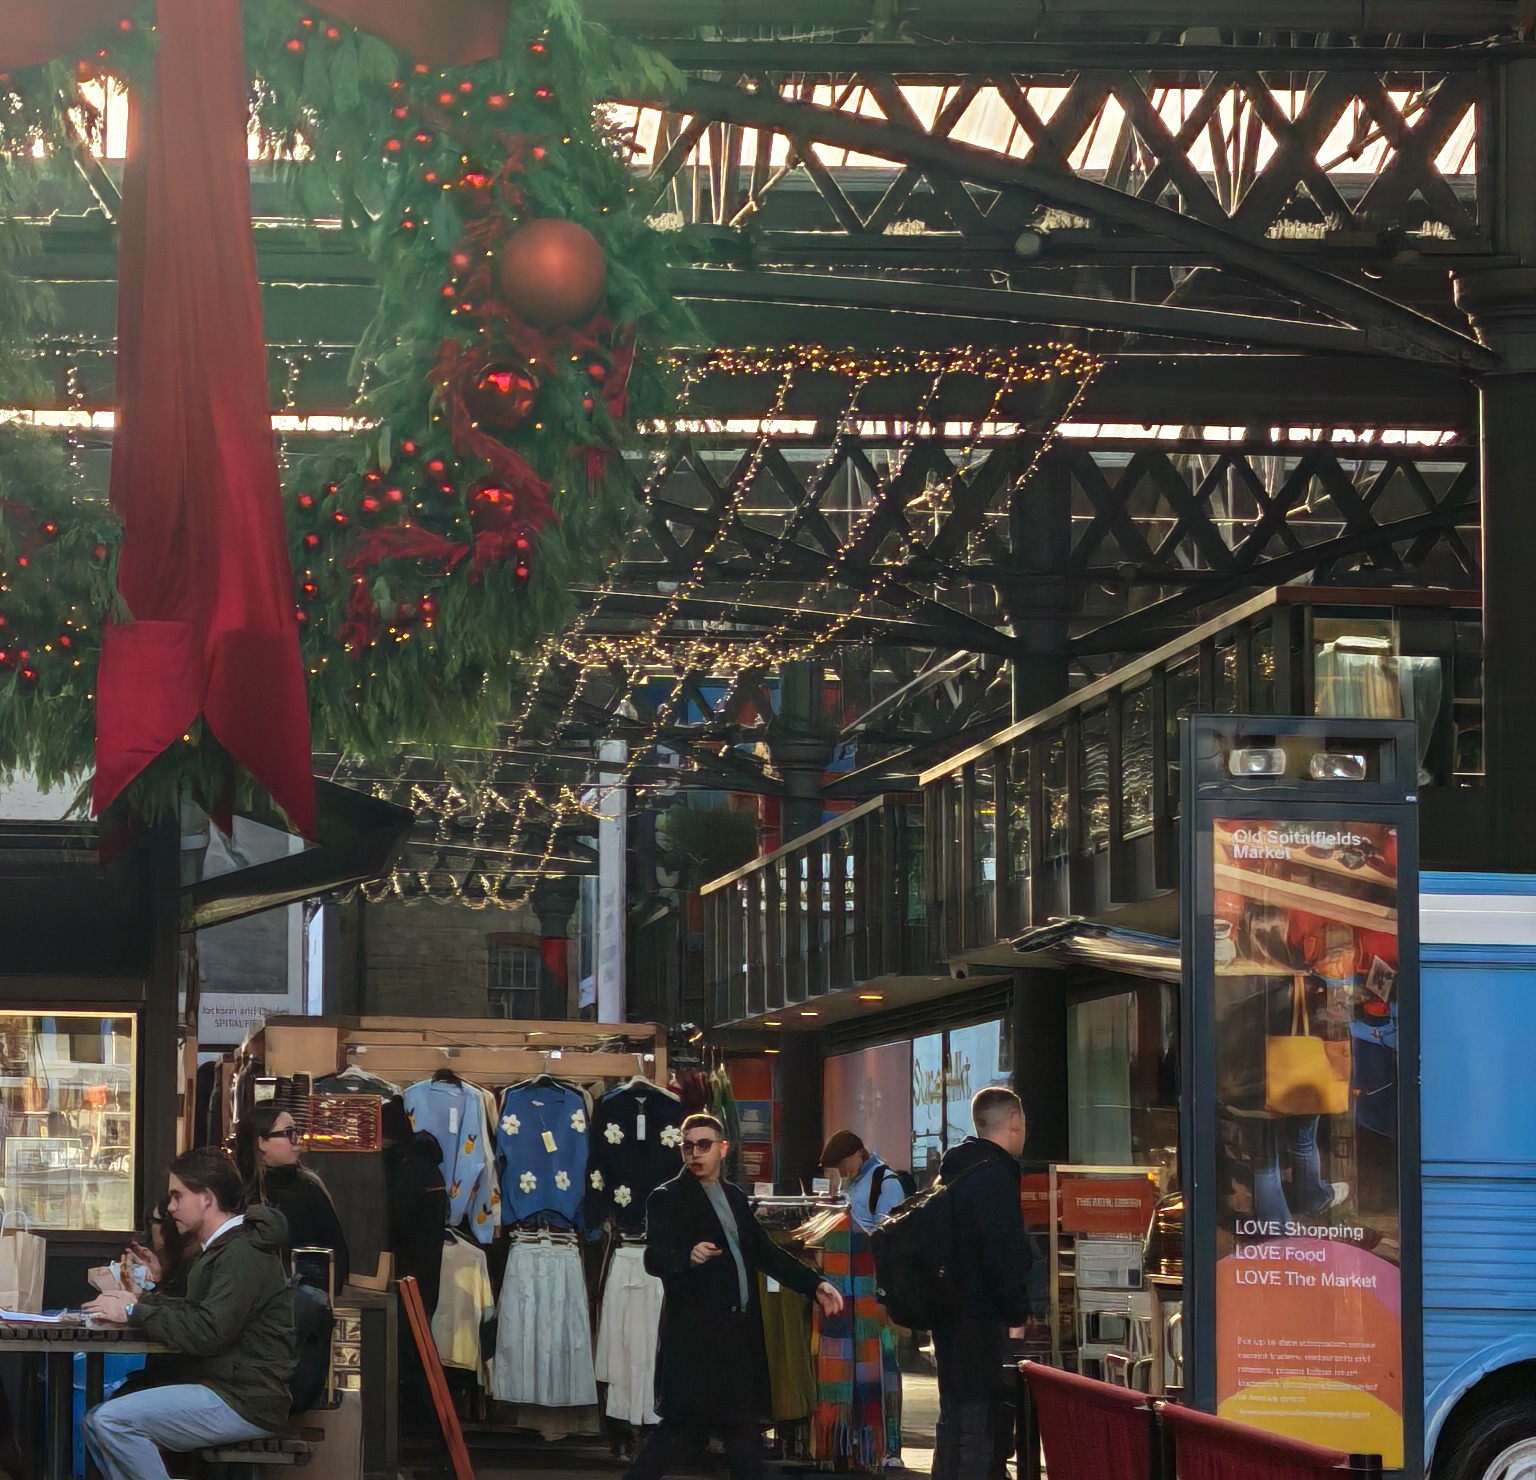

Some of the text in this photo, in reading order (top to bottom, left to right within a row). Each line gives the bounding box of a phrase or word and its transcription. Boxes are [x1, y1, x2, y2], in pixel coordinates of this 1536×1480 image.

[1233, 829, 1362, 847] Old Spitalfields
[1233, 844, 1292, 859] Market
[1235, 1220, 1364, 1241] LOVE Shopping
[1235, 1245, 1326, 1262] LOVE Food
[1235, 1269, 1377, 1288] LOVE The Market
